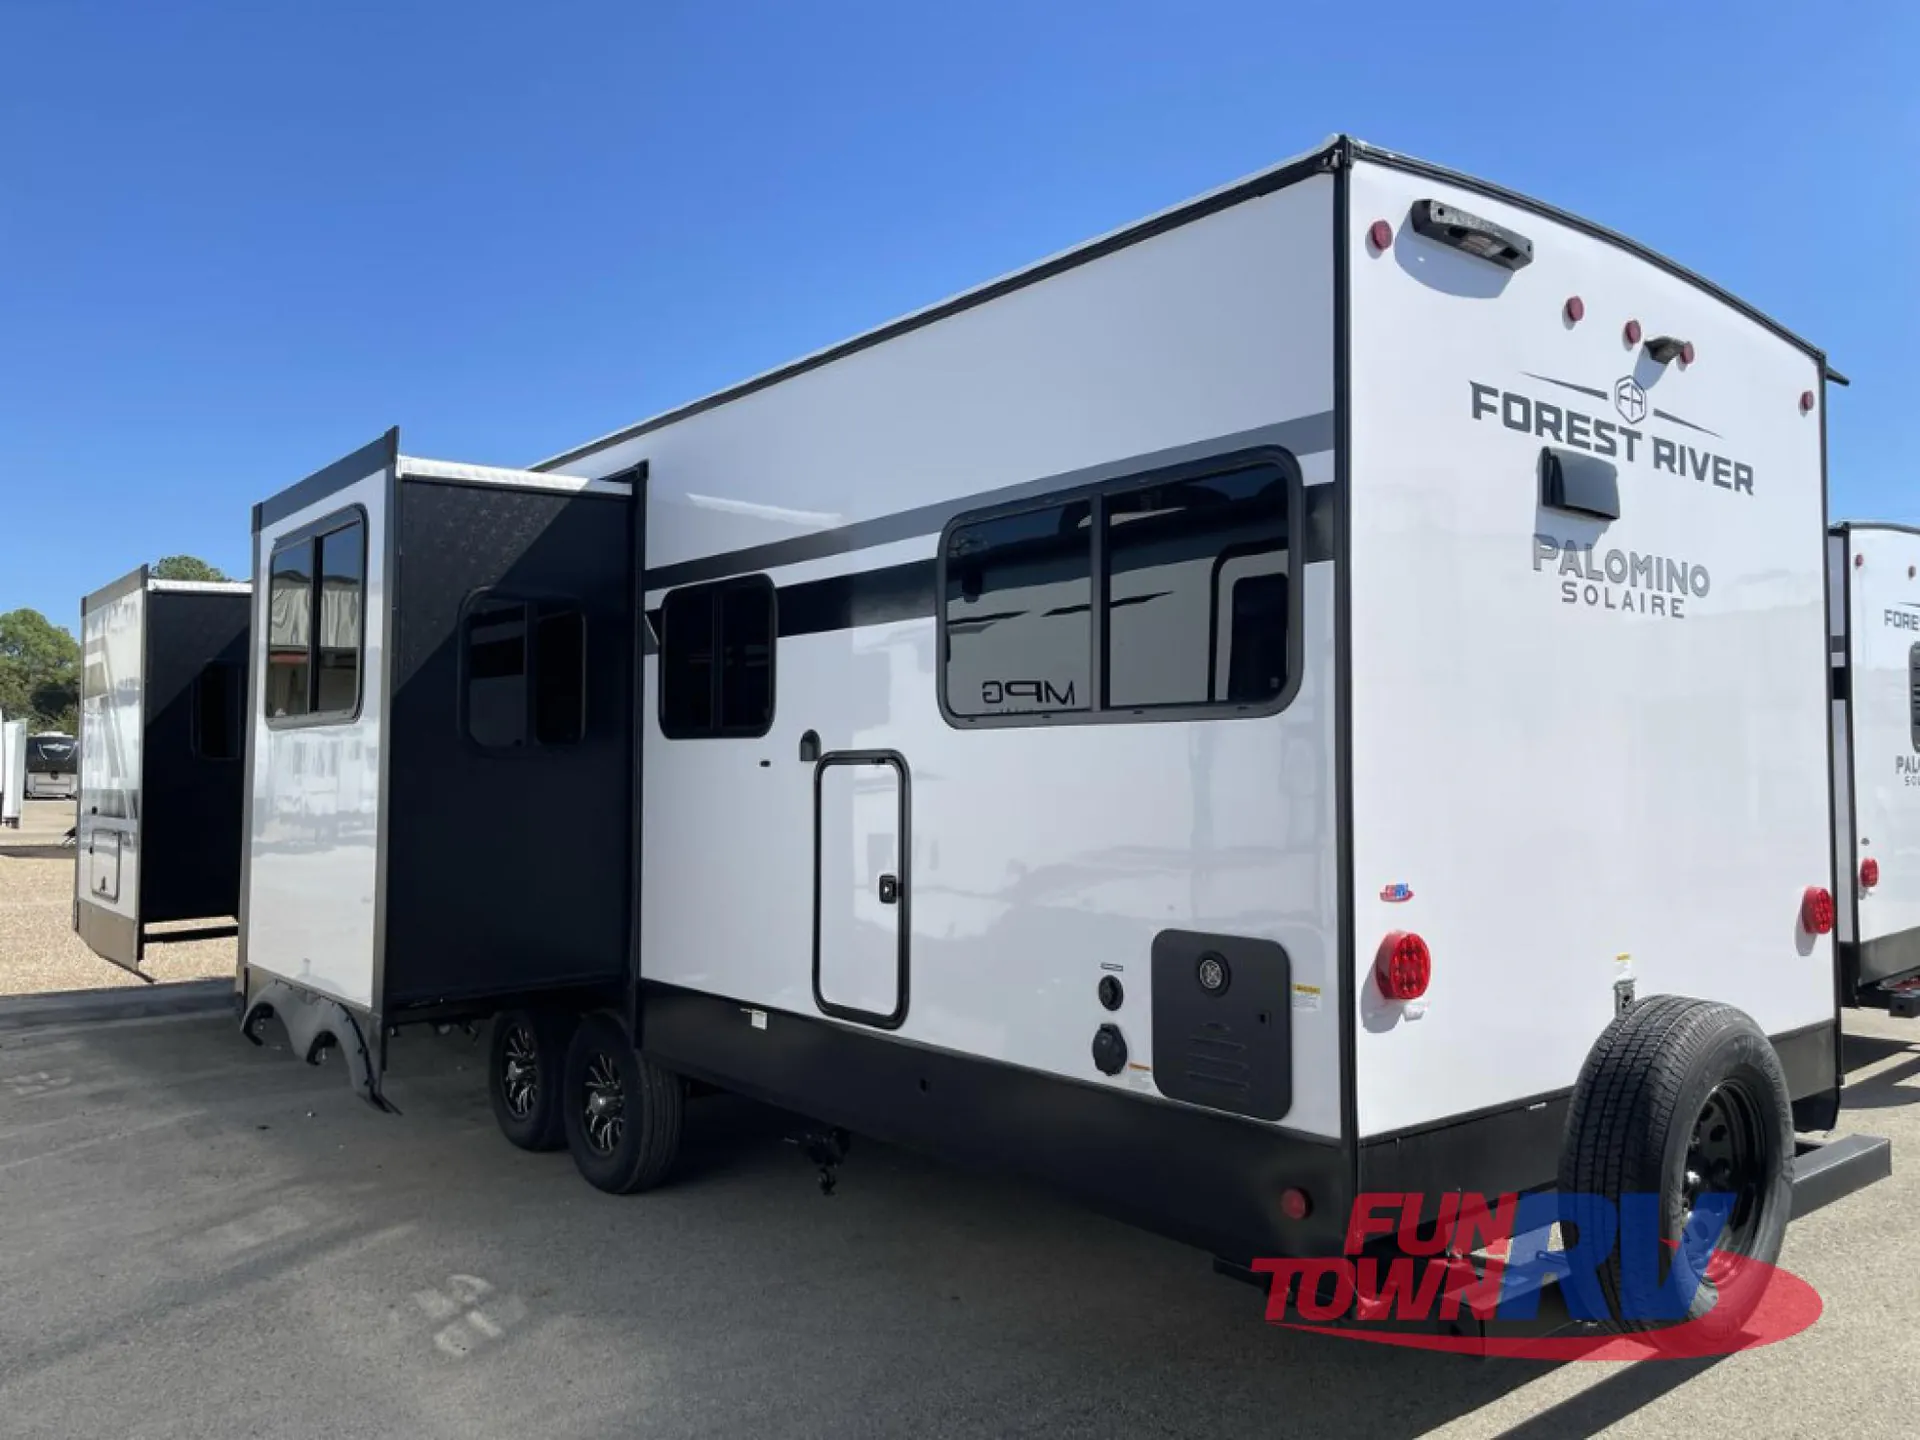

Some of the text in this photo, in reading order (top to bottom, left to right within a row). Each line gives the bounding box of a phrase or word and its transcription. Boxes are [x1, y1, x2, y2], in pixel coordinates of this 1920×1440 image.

[1469, 380, 1754, 496] FOREST RIVER
[1533, 533, 1710, 598] PALOMINO
[1561, 581, 1685, 619] SOLAIRE
[1895, 755, 1920, 774] PAL
